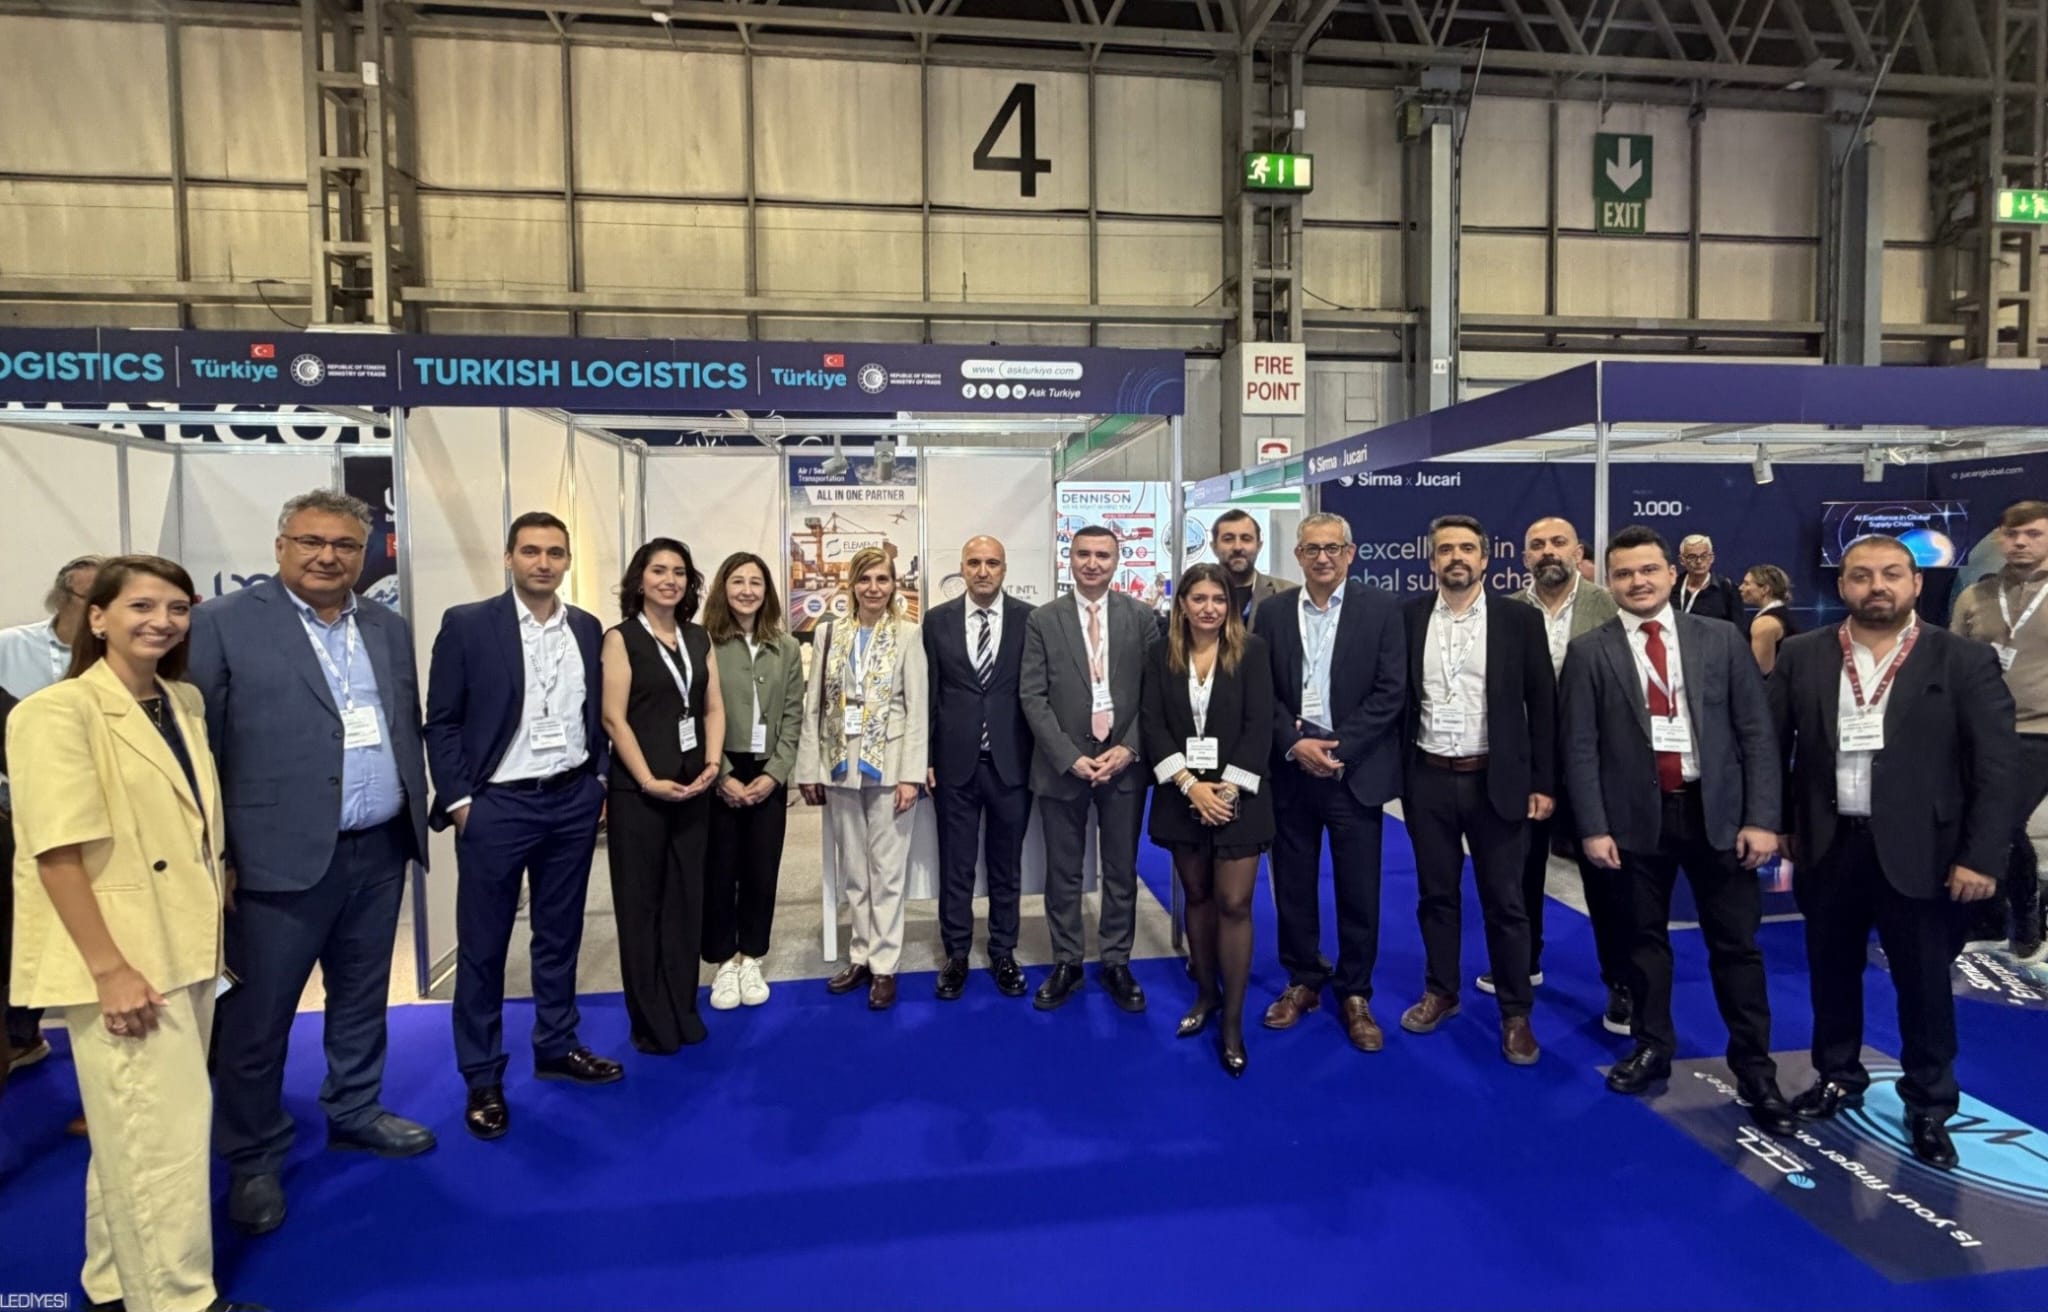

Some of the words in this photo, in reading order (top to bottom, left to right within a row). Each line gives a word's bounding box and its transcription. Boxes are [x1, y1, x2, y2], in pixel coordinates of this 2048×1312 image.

[973, 82, 1052, 198] 4
[1603, 201, 1642, 229] EXIT
[191, 358, 278, 383] Türkiye
[413, 357, 560, 387] TURKISH
[571, 359, 747, 390] LOGISTICS
[1254, 355, 1294, 375] FIRE
[771, 367, 847, 391] Türkiye
[1247, 381, 1301, 401] POINT
[1028, 388, 1046, 398] Ask
[1316, 455, 1338, 473] Sirma
[1343, 443, 1368, 467] Jucari
[1358, 471, 1402, 487] Sirma
[1415, 471, 1461, 487] Jucari
[816, 489, 833, 501] ALL
[834, 489, 844, 501] IN
[845, 489, 864, 501] ONE
[865, 489, 905, 501] PARTNER
[1061, 493, 1131, 504] DENNISON
[1358, 535, 1429, 560] excell
[1494, 536, 1514, 559] in
[1818, 1148, 1891, 1192] finger
[1886, 1191, 1957, 1229] your
[1950, 1229, 1982, 1247] Is
